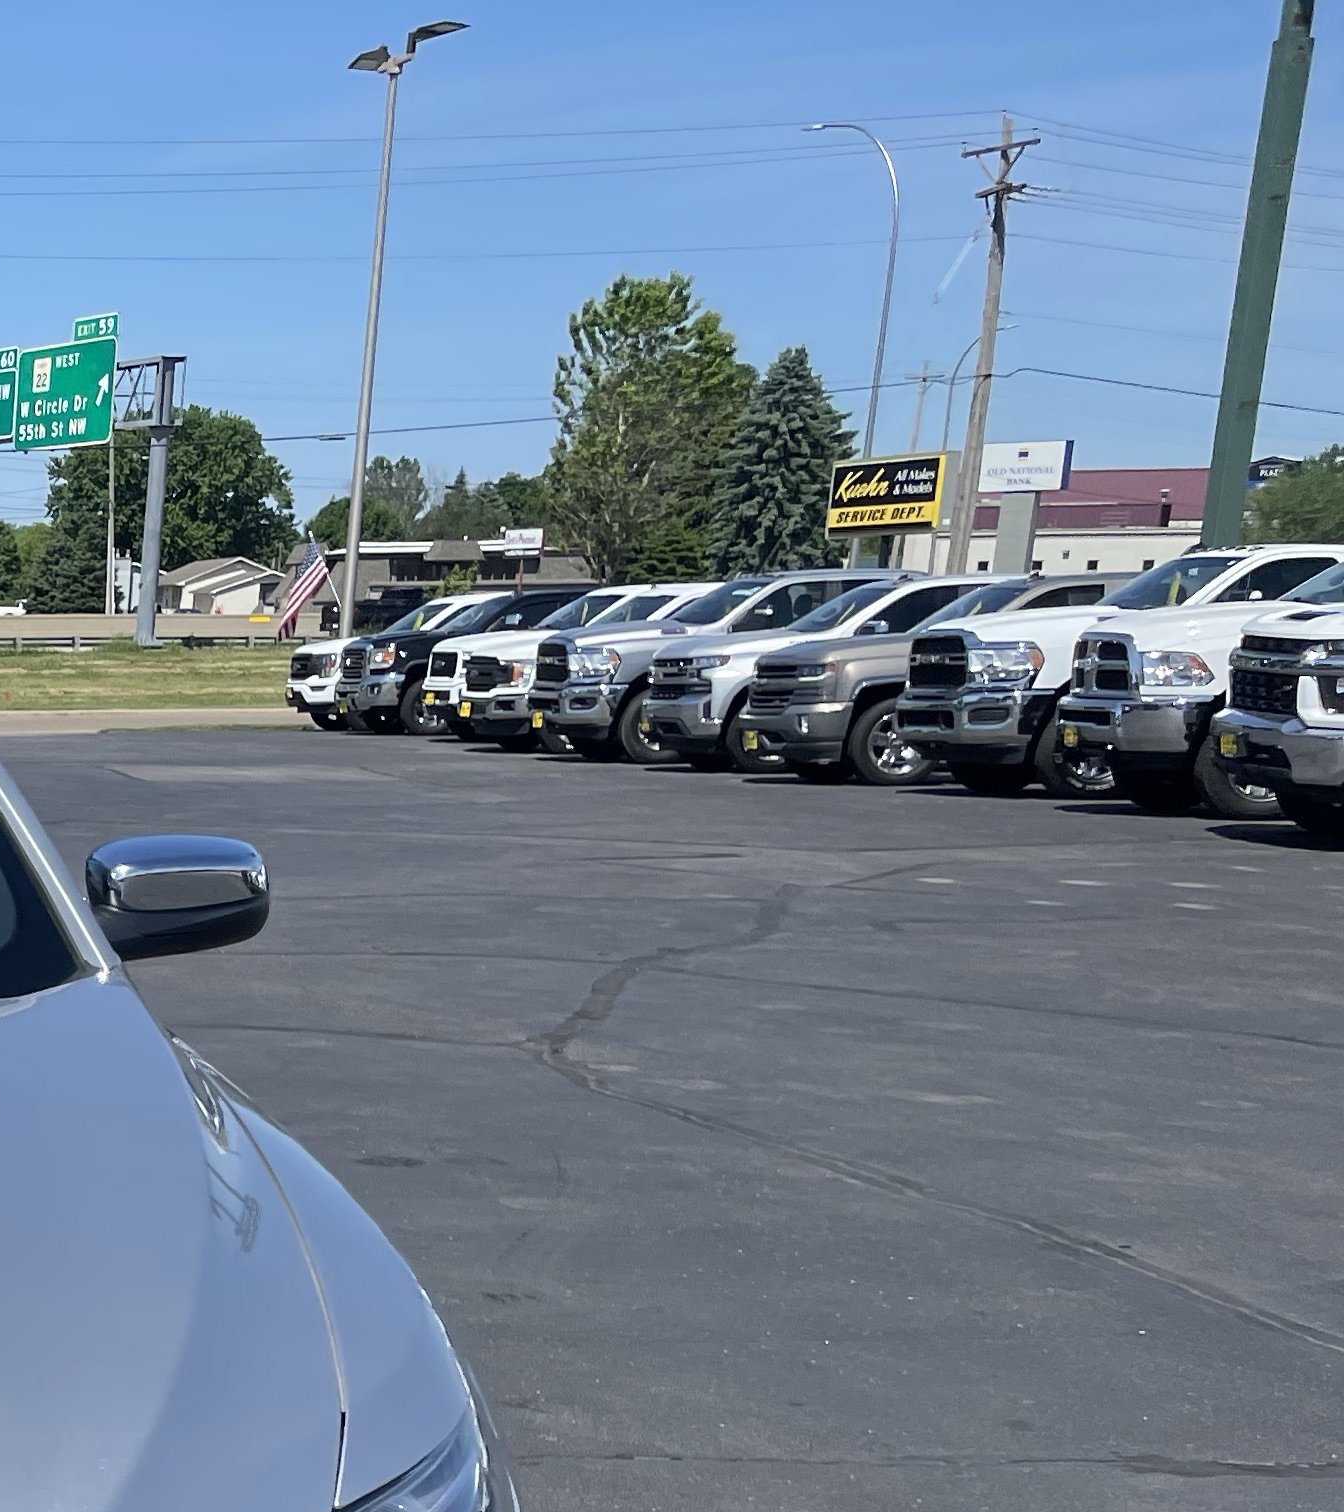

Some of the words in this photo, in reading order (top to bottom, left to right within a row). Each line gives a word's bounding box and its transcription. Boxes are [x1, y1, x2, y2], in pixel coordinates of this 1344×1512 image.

[77, 322, 96, 337] EXIT
[98, 317, 115, 336] 59
[0, 351, 15, 368] 60
[55, 352, 81, 368] WEST
[35, 372, 48, 388] 22
[20, 401, 30, 418] W
[34, 397, 69, 417] Circle
[73, 394, 88, 412] Dr
[18, 423, 46, 442] 55th
[50, 421, 63, 437] St
[68, 418, 87, 436] NW
[987, 466, 1007, 477] OLD
[1009, 465, 1055, 476] NATIONAL
[834, 467, 890, 503] Kuehn
[893, 469, 909, 481] All
[908, 467, 936, 481] Makes
[892, 483, 901, 495] &
[901, 481, 933, 495] Models
[1006, 477, 1032, 486] BANK
[836, 507, 888, 524] SERVICE
